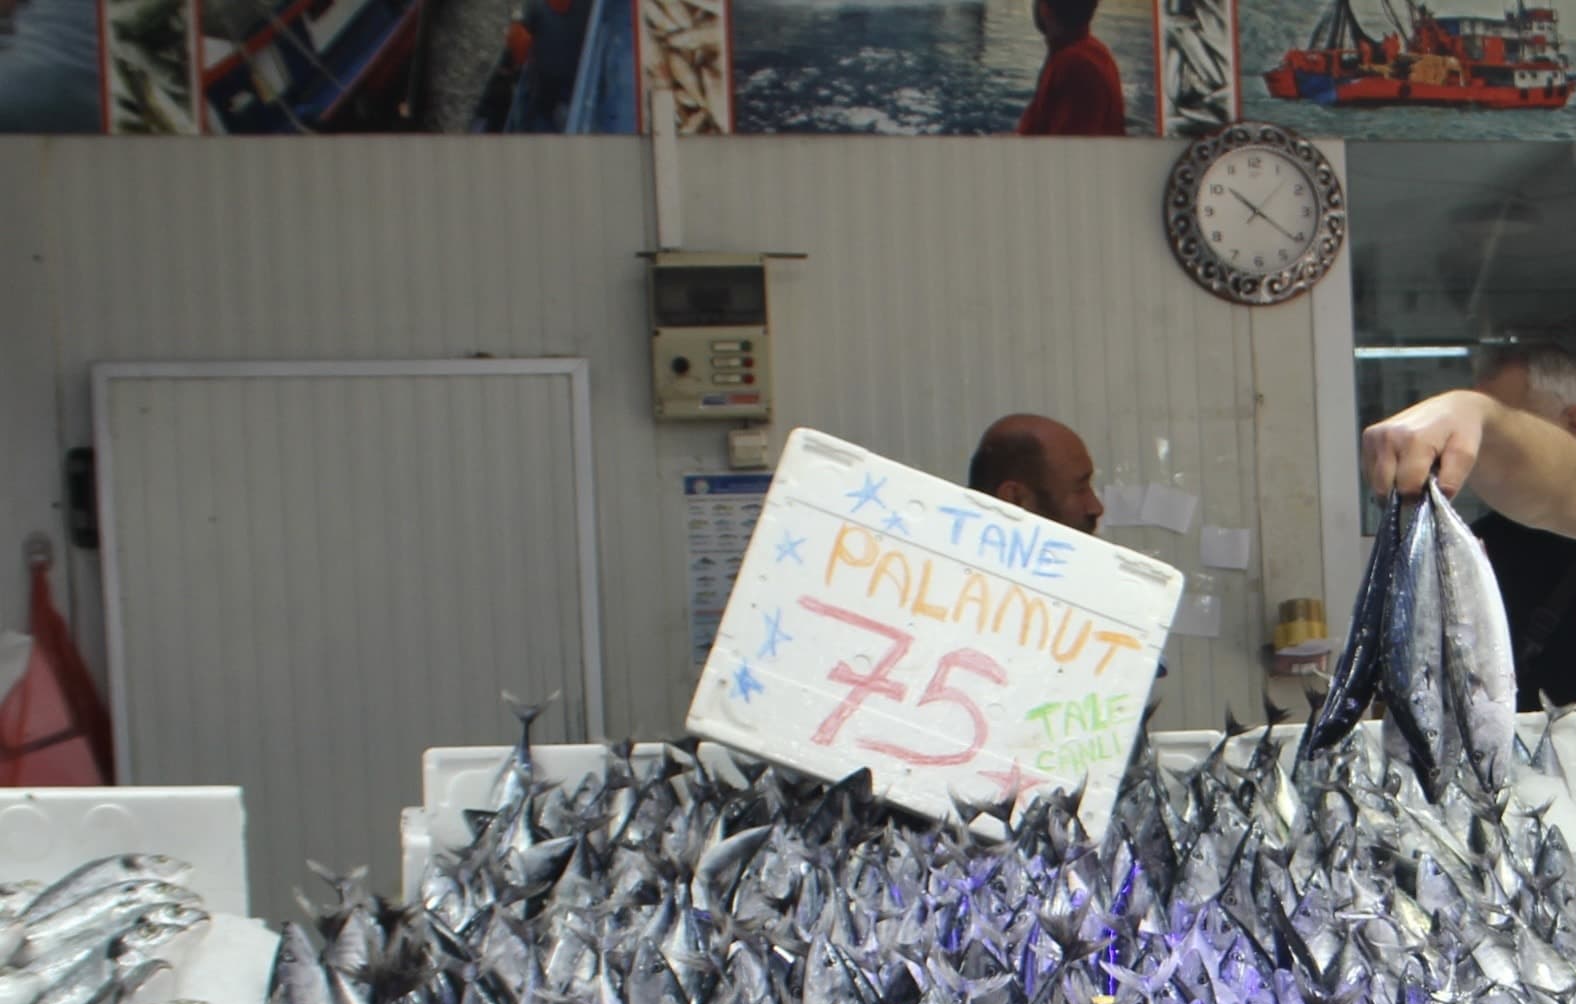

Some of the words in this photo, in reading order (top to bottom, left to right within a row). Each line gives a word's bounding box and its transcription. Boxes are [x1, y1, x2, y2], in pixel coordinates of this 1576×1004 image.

[825, 523, 1142, 675] PALAMUT
[938, 506, 1076, 578] TANE
[796, 595, 1009, 767] 75
